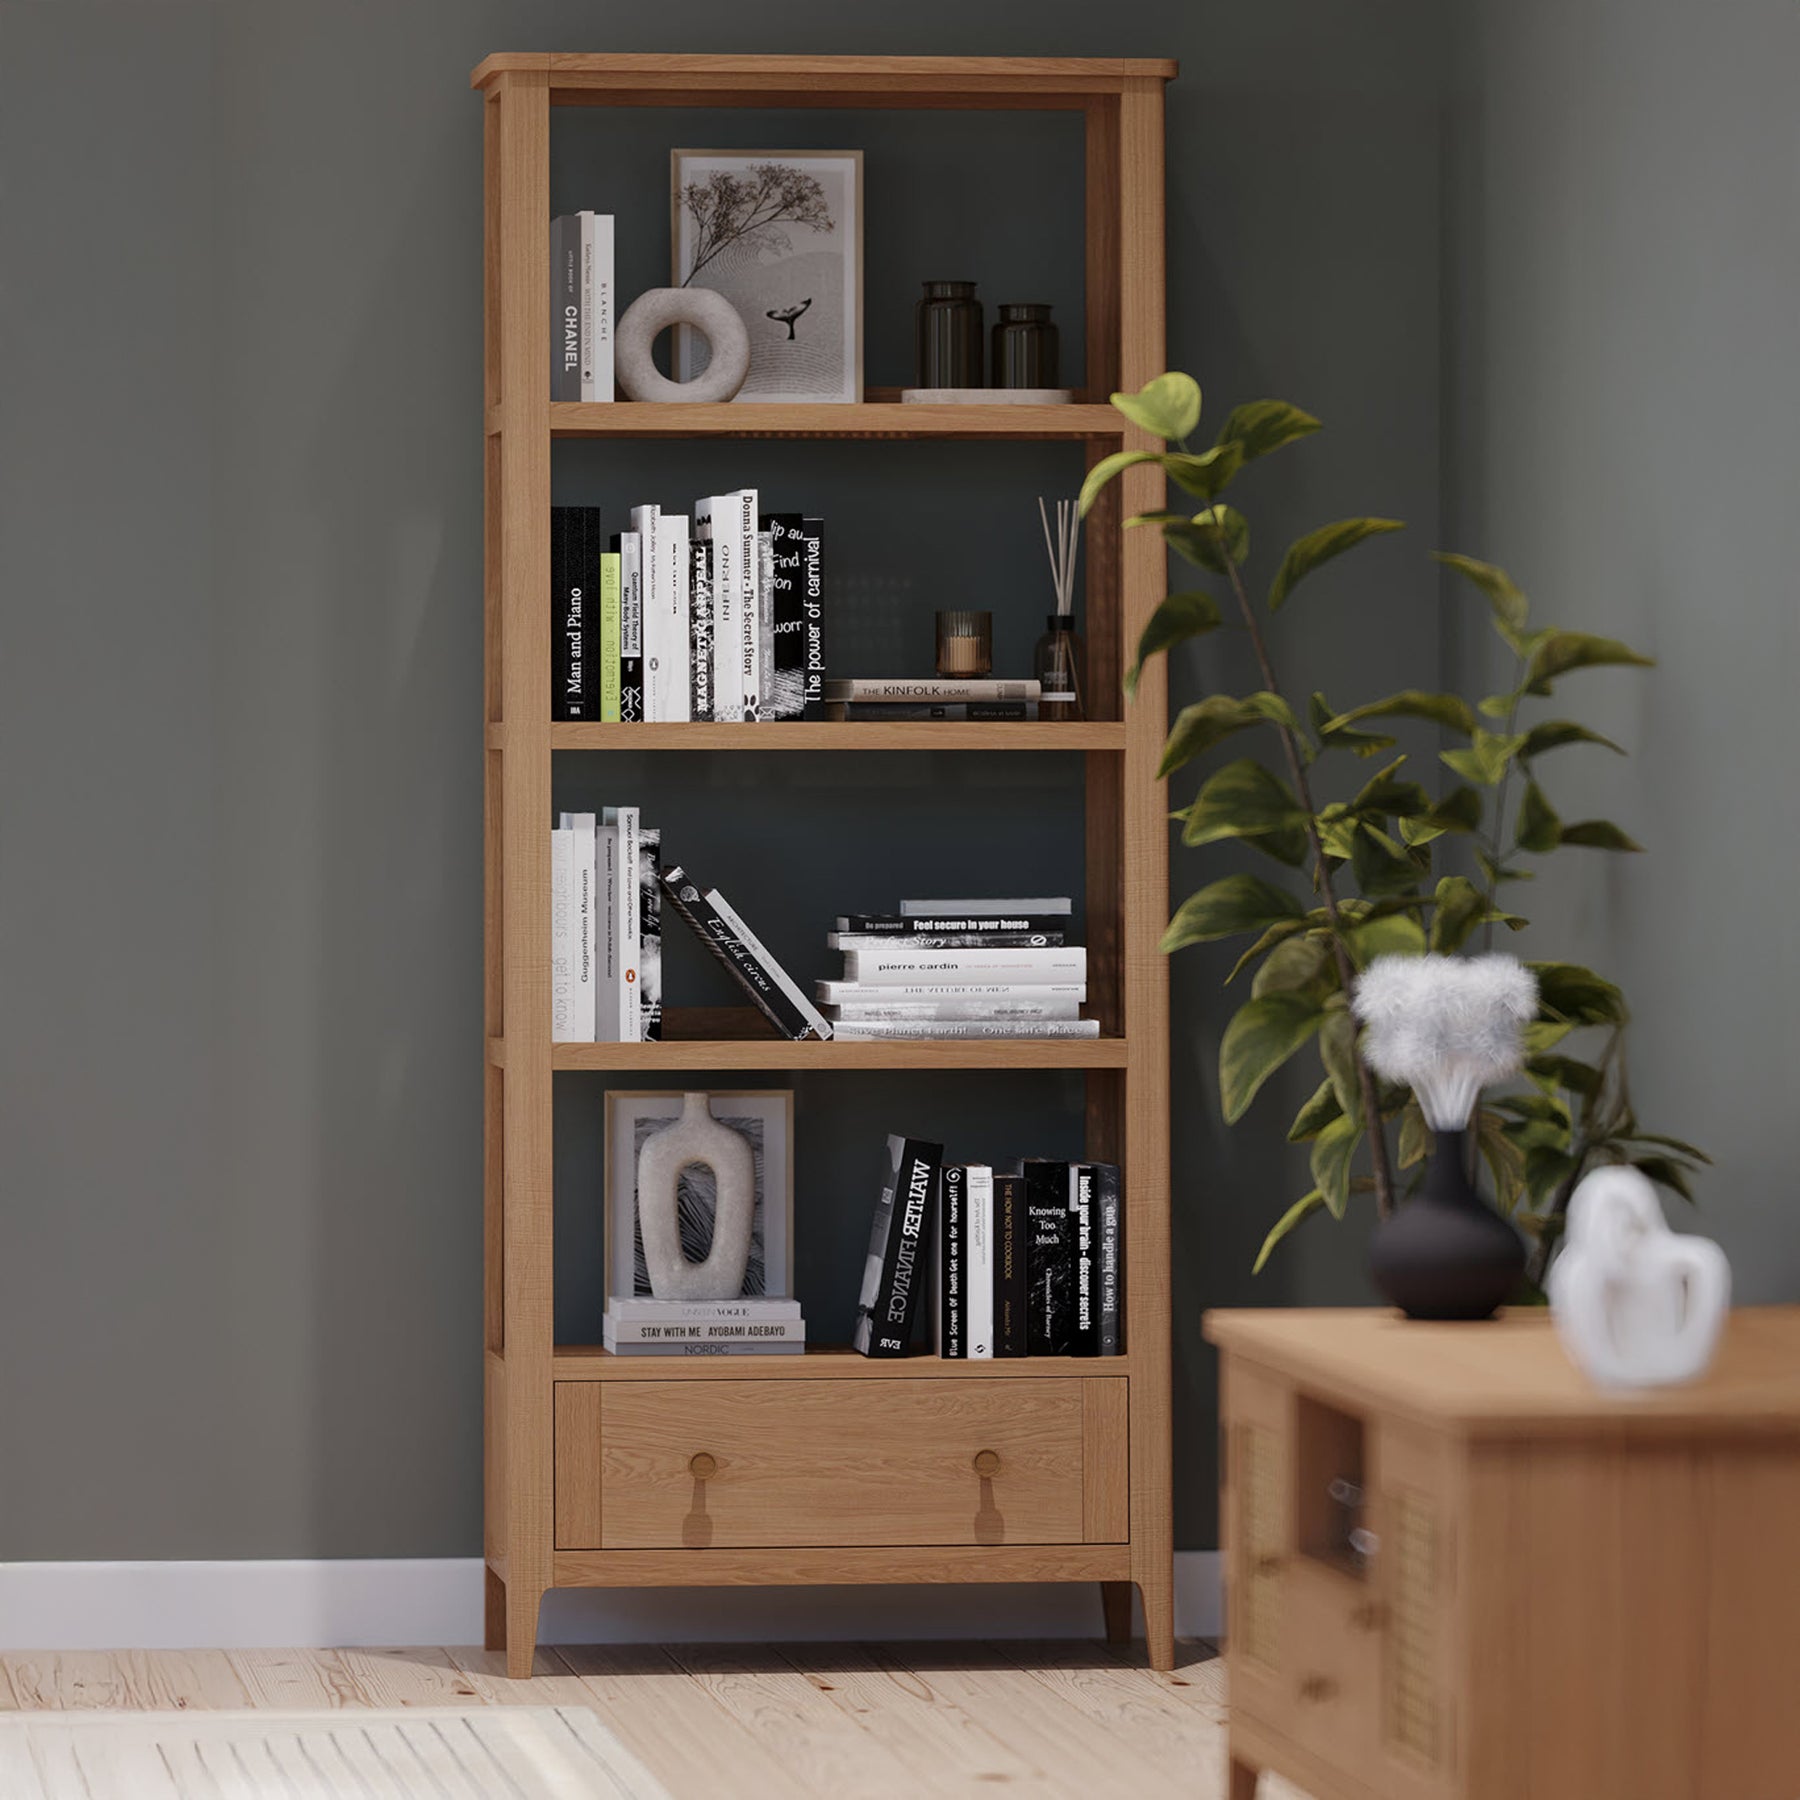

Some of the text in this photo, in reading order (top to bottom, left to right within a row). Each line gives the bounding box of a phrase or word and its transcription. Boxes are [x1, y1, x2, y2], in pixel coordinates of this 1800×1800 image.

[564, 306, 578, 372] CHANEL
[742, 496, 753, 532] Donna
[743, 534, 754, 580] Summer
[566, 588, 582, 632] Piano
[744, 589, 754, 609] The
[630, 620, 639, 642] Theory
[744, 612, 754, 645] Secret
[803, 536, 826, 704] The power of carnival
[622, 624, 630, 650] Systems
[566, 634, 583, 666] and
[744, 647, 754, 676] Story
[566, 667, 582, 694] Man
[862, 686, 970, 696] THE KINFOLK HOME
[626, 814, 634, 839] Samuel
[626, 840, 634, 864] Beckett
[626, 890, 634, 902] and
[580, 868, 589, 983] Guggenheim Museum
[727, 914, 758, 952] ARCHITECTURE
[914, 920, 933, 930] Feel
[934, 920, 966, 930] secure
[968, 920, 977, 930] in
[978, 920, 999, 931] your
[1000, 920, 1029, 930] house
[912, 936, 946, 948] Story
[707, 916, 746, 962] English
[743, 962, 772, 992] circus
[878, 962, 916, 972] pierre
[919, 962, 958, 970] cardin
[883, 1026, 926, 1036] Planet
[982, 1026, 1012, 1035] One
[1080, 1176, 1091, 1204] Inside
[1028, 1206, 1066, 1218] Knowing
[1078, 1205, 1090, 1226] your
[1105, 1206, 1117, 1226] gun
[950, 1226, 958, 1240] for
[1004, 1184, 1012, 1280] THE HOW NOT TO COOKBOOK
[1039, 1220, 1056, 1231] Too
[950, 1242, 958, 1256] one
[1036, 1234, 1060, 1245] Much
[1080, 1226, 1091, 1250] brain
[950, 1258, 958, 1272] Get
[1102, 1236, 1115, 1272] handle
[950, 1272, 958, 1294] Death
[1080, 1258, 1091, 1296] discover
[1103, 1274, 1115, 1286] to
[1046, 1305, 1054, 1314] of
[1102, 1286, 1115, 1312] How
[716, 1308, 750, 1317] VOGUE
[950, 1310, 958, 1336] Screen
[1080, 1296, 1090, 1330] secrets
[641, 1326, 786, 1338] STAY WITH ME AYOBAMI ADEBAYO
[684, 1344, 730, 1355] NORDIC
[950, 1338, 958, 1356] Blue
